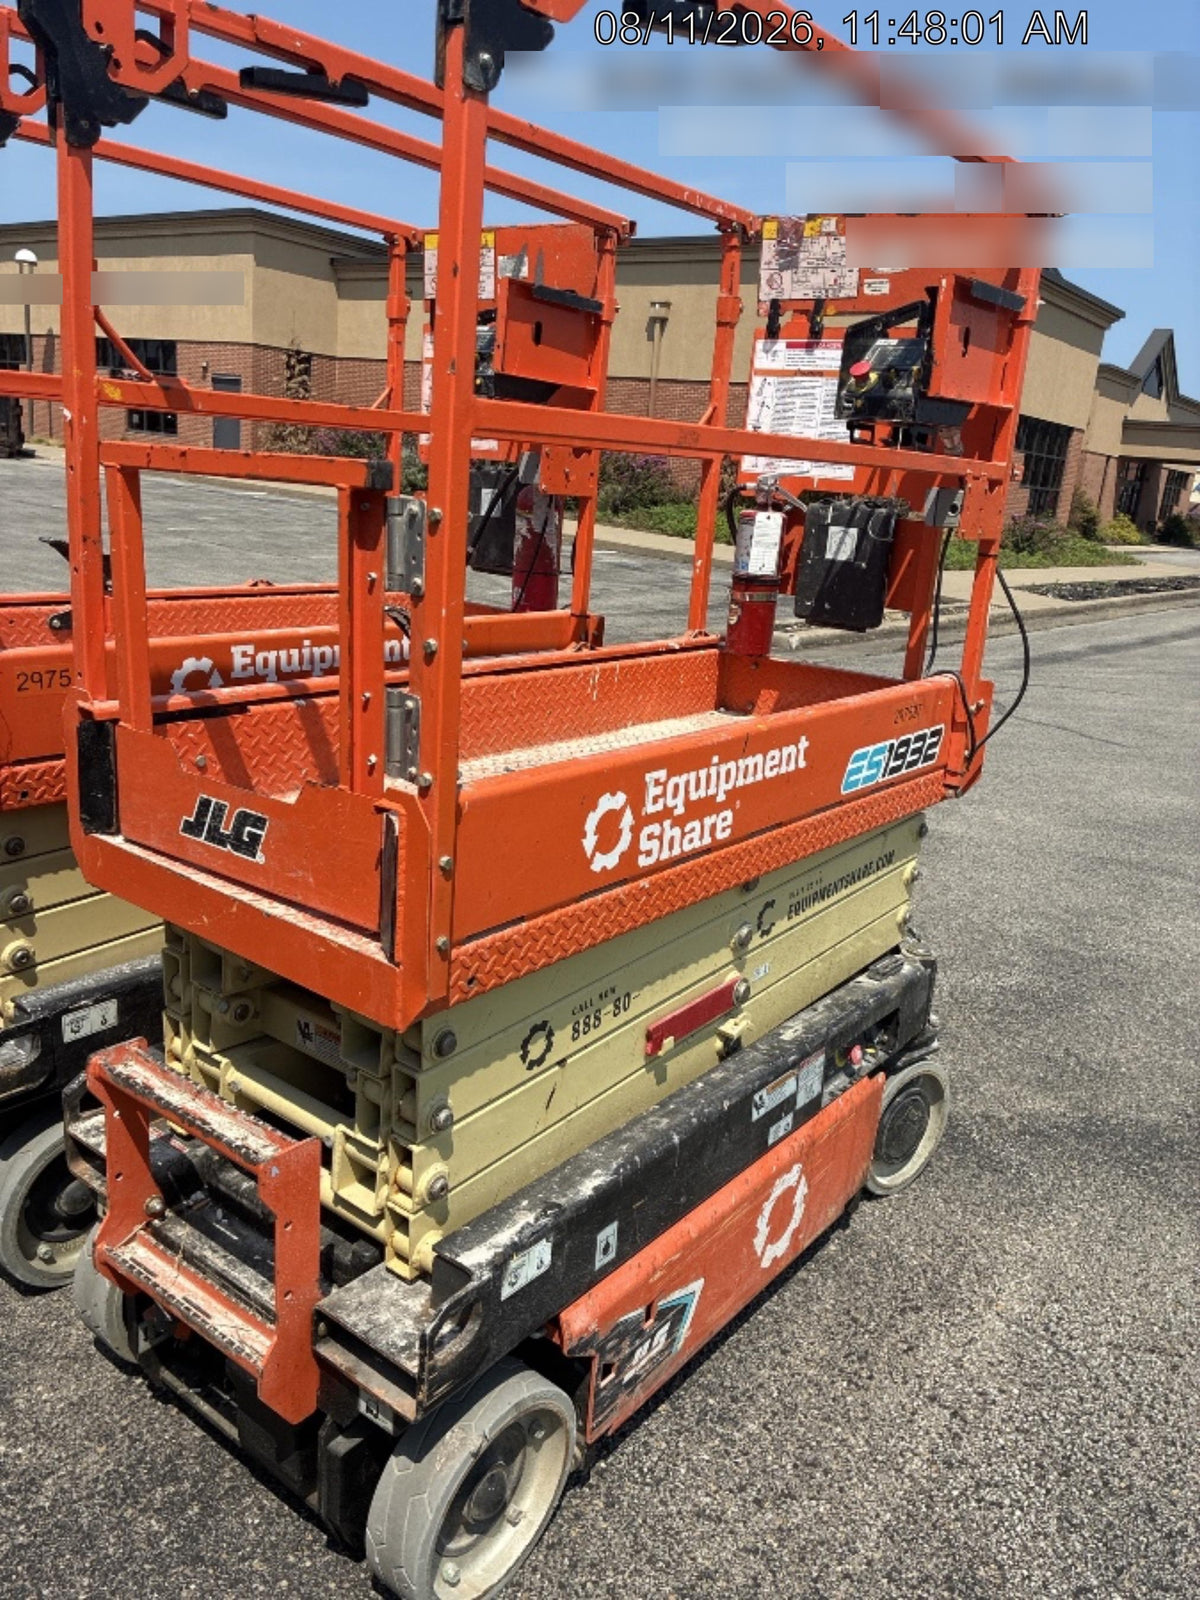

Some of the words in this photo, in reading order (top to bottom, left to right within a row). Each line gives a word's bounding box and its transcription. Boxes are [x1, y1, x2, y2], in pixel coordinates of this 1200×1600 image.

[230, 634, 411, 682] Equipnt
[642, 735, 809, 815] Equipment
[841, 723, 945, 794] ES1932
[179, 793, 269, 863] JLG
[638, 808, 733, 867] Share
